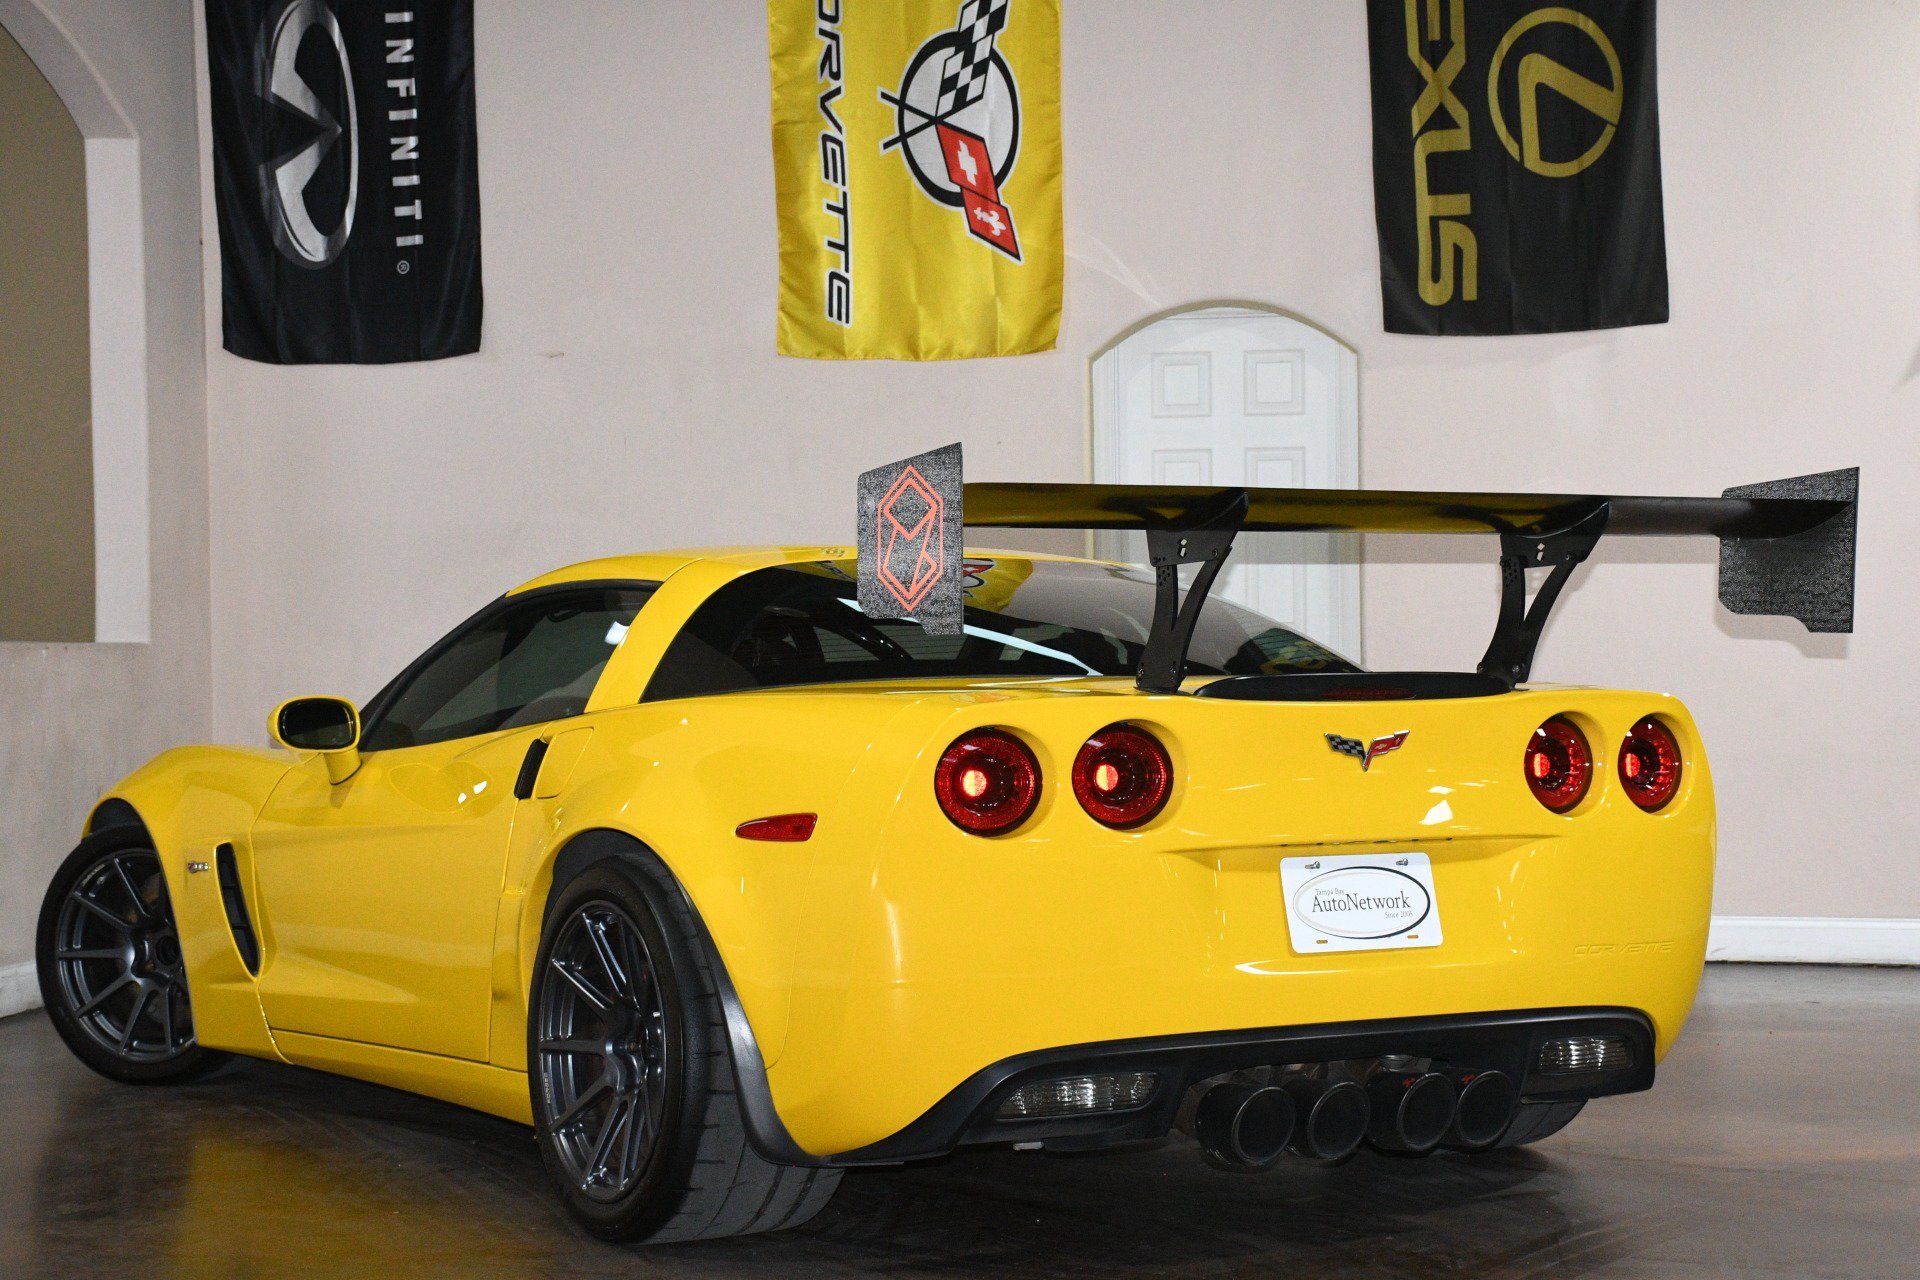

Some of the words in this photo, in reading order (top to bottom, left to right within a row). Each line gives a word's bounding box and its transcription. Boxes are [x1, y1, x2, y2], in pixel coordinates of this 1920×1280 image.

[385, 11, 424, 247] INFINITI
[1312, 890, 1411, 912] AutoNetwork
[1315, 888, 1334, 897] Tampa
[1335, 887, 1345, 896] Bay
[1574, 940, 1674, 955] CORVETTE
